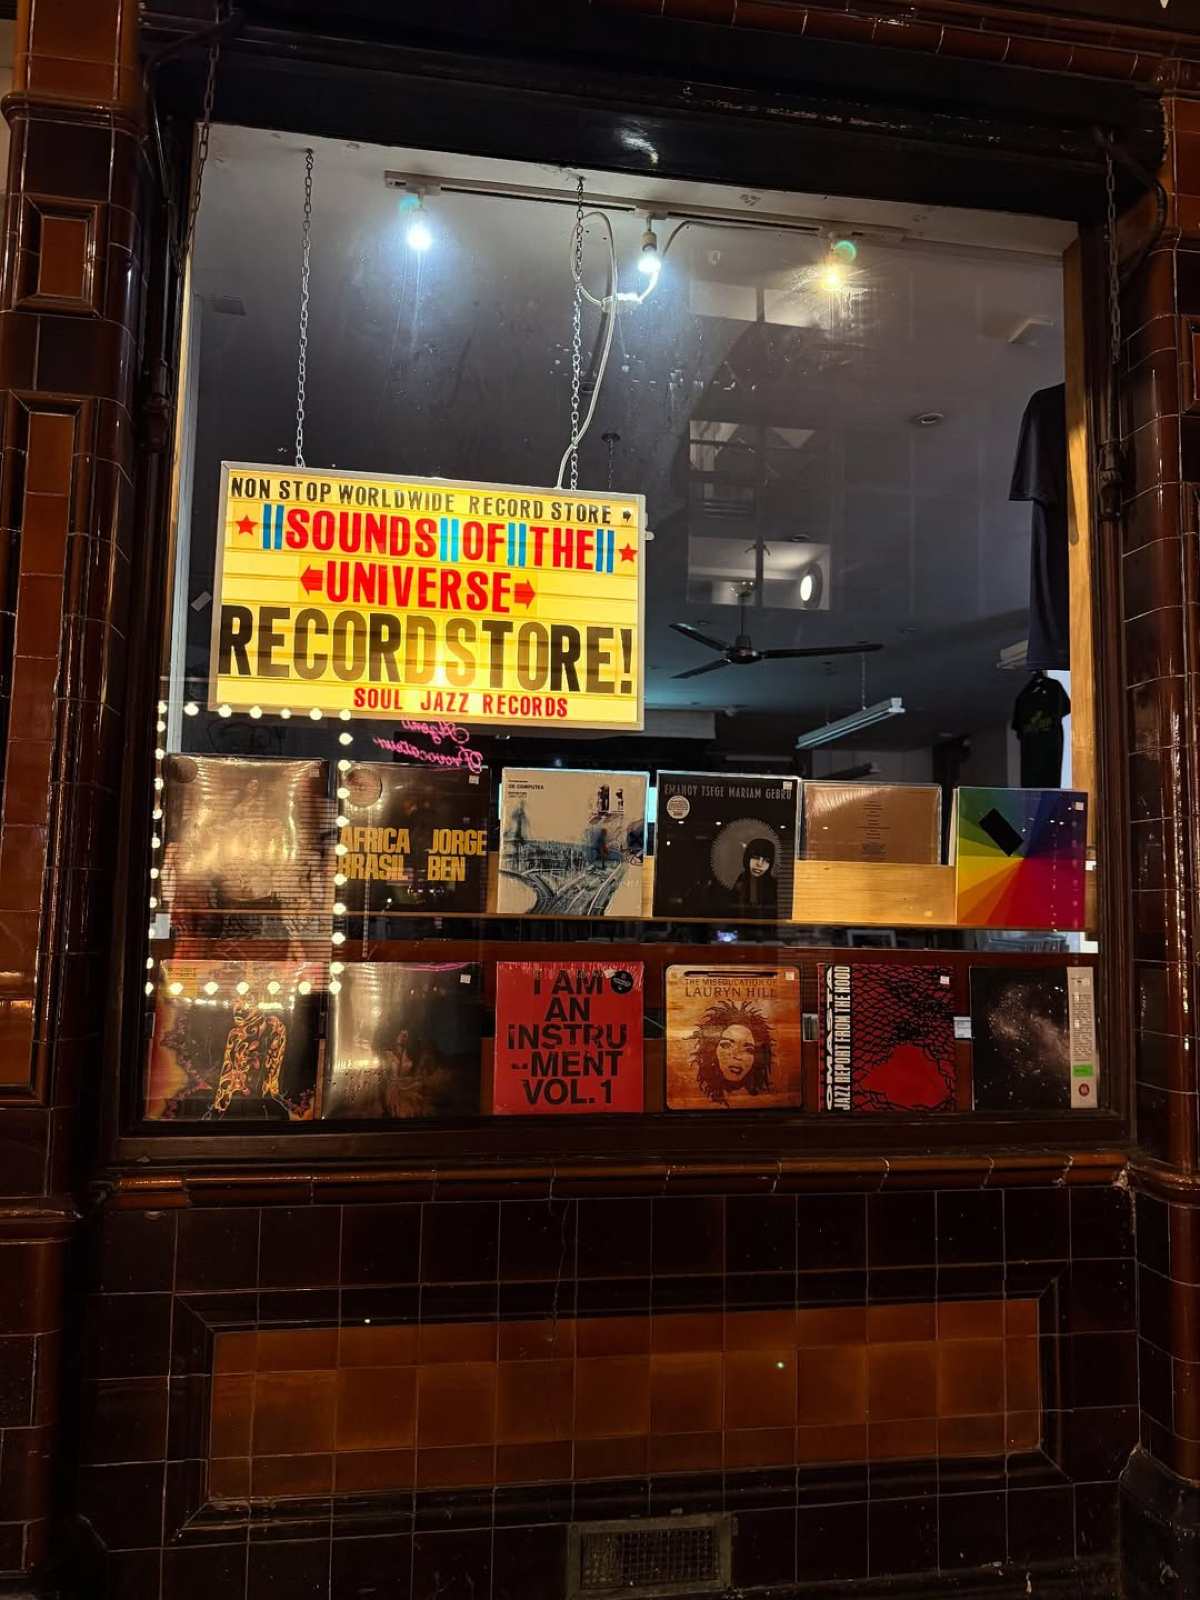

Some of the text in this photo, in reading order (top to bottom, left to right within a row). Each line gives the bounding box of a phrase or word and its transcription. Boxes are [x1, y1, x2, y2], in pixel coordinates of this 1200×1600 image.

[231, 477, 612, 525] NON STOP WORLDWIDE RECORD STORE
[286, 508, 595, 570] SOUNDS OF THE
[327, 560, 512, 613] UNIVERSE
[353, 687, 568, 717] SOUL JAZZ RECORDS
[340, 826, 487, 856] AFRICA JORGE
[337, 853, 466, 881] BRASIL BEN
[552, 969, 603, 994] AM
[685, 987, 777, 998] LAURYN HILL
[546, 998, 591, 1022] AN
[834, 995, 851, 1012] THE
[834, 1015, 851, 1042] FROM
[834, 1044, 851, 1083] REPORT
[522, 1079, 612, 1105] VOL. 1
[834, 1085, 851, 1111] JAZZ
